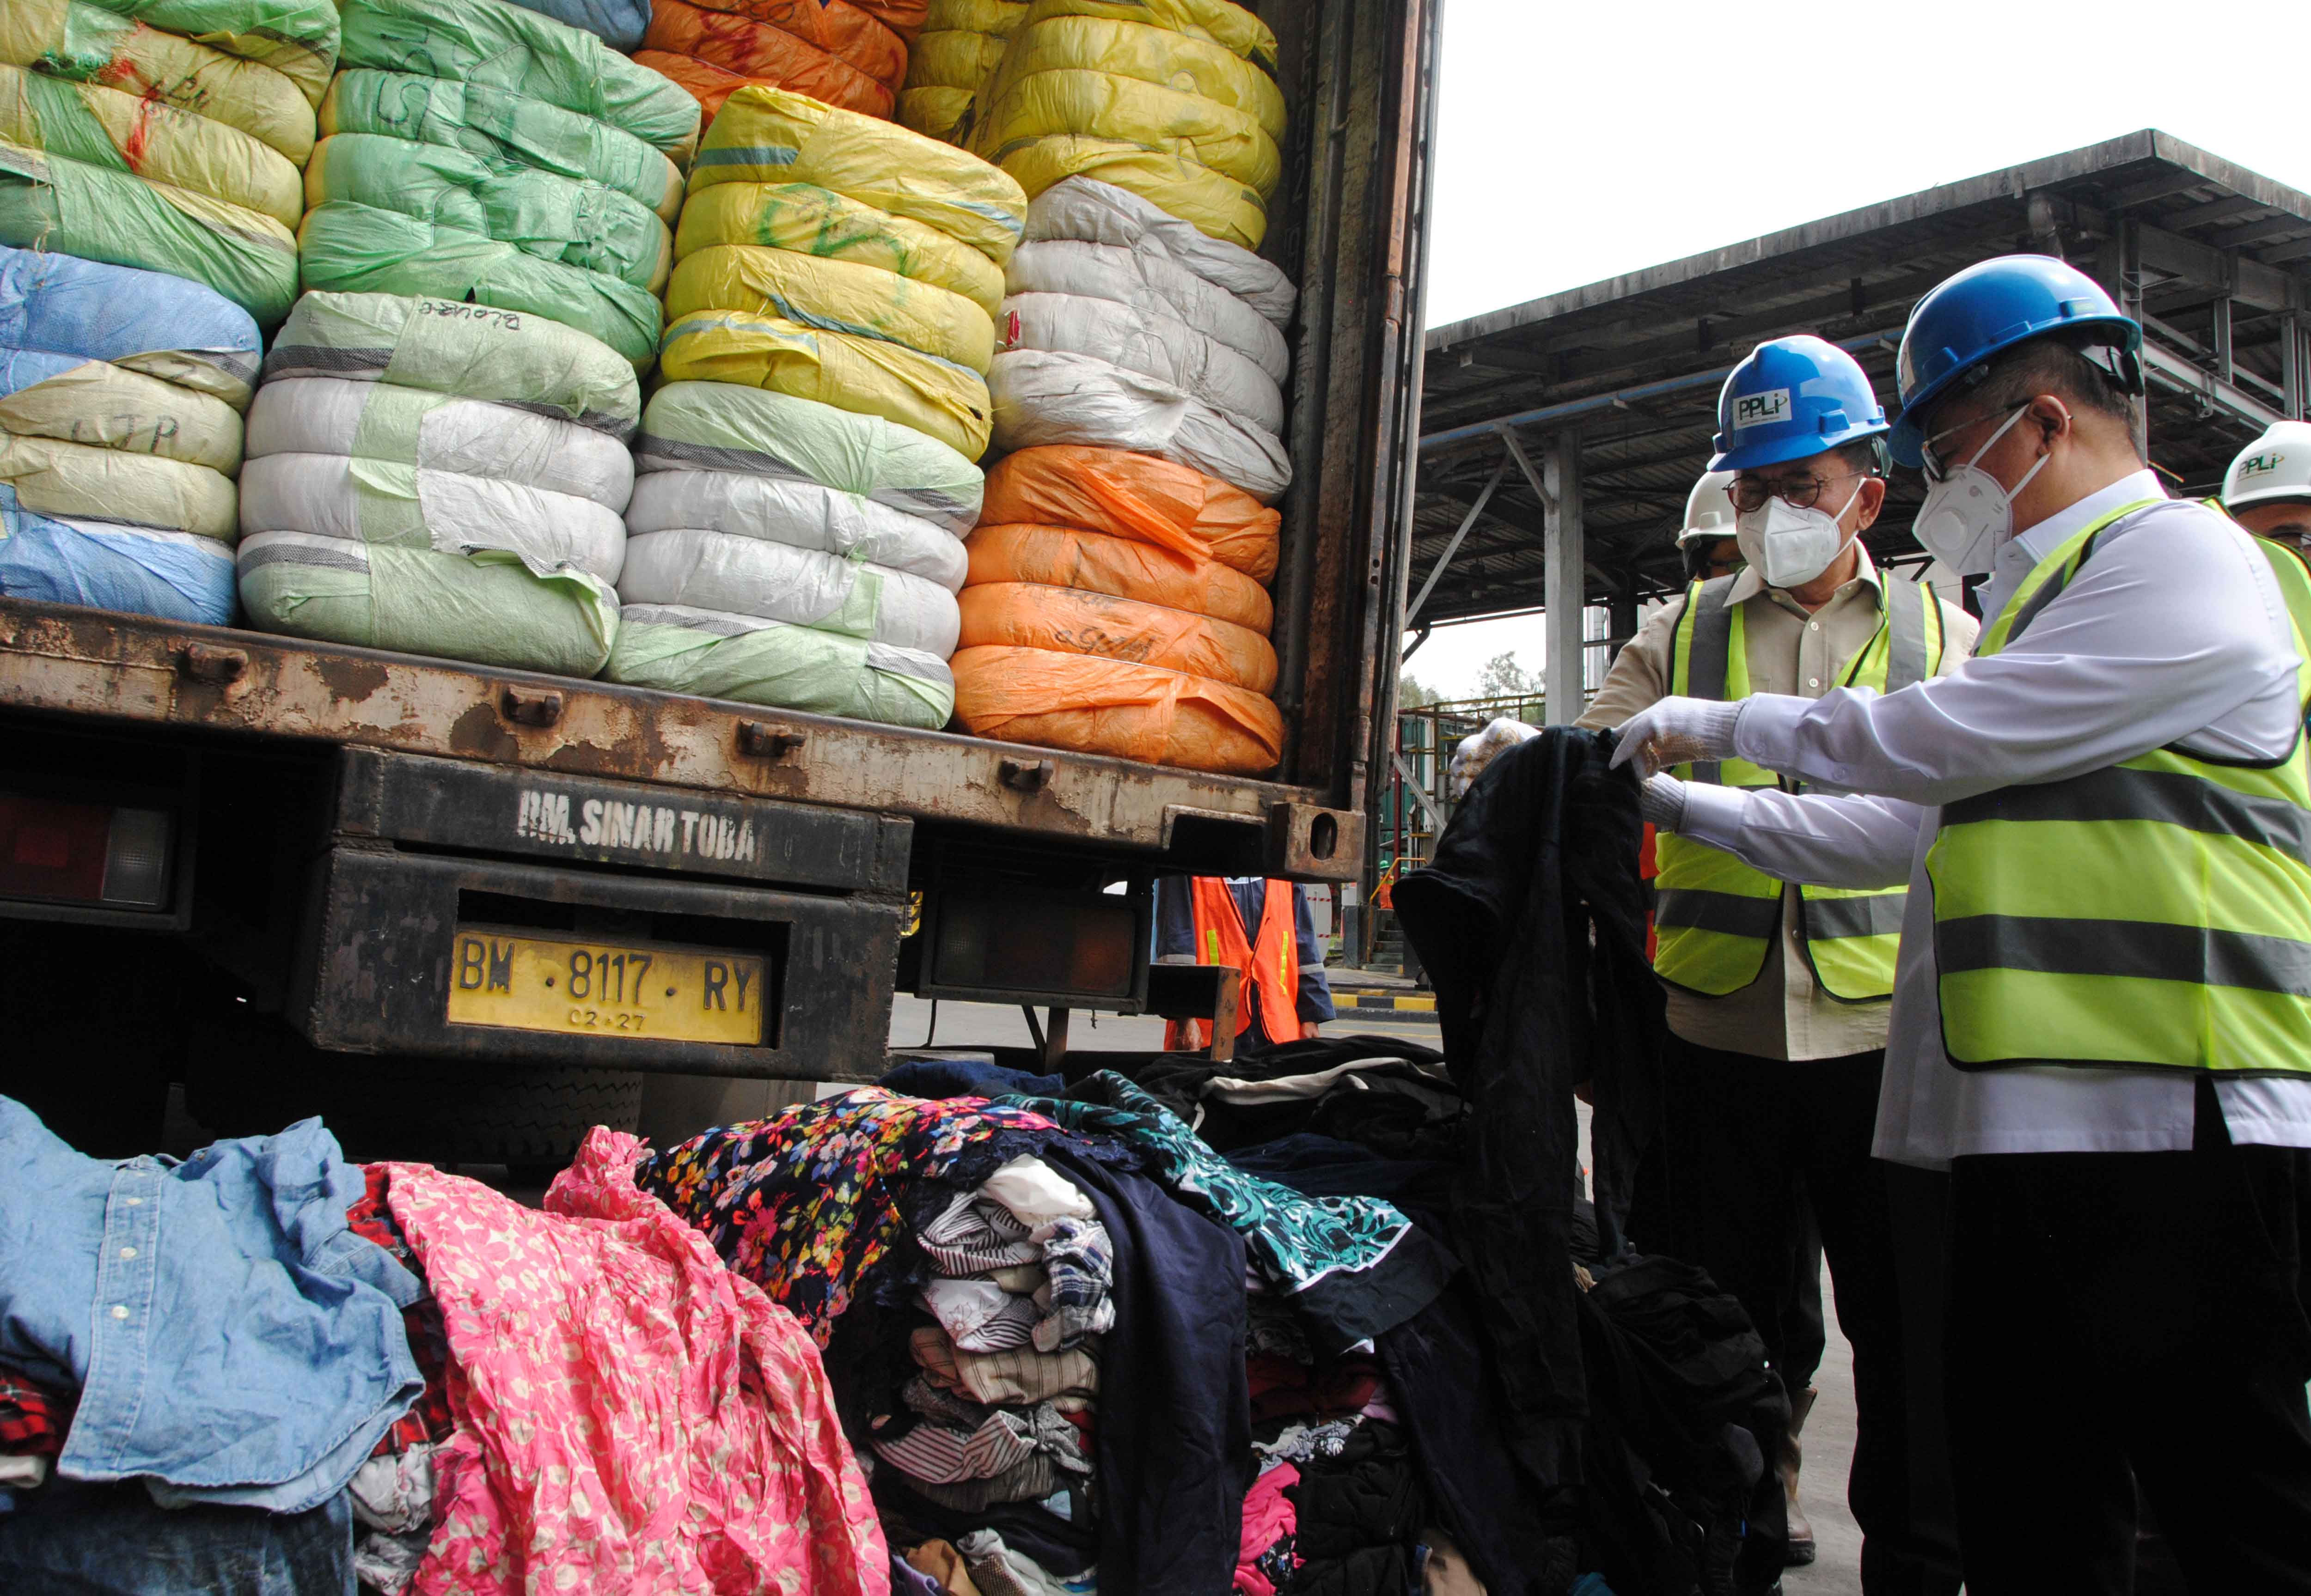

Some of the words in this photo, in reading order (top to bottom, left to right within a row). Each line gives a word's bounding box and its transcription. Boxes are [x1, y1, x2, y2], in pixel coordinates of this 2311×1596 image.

[580, 799, 675, 853] SINAR
[681, 810, 754, 861] TOBA
[459, 939, 514, 993] BM
[569, 950, 653, 1005] 8117
[704, 961, 752, 1011] RY
